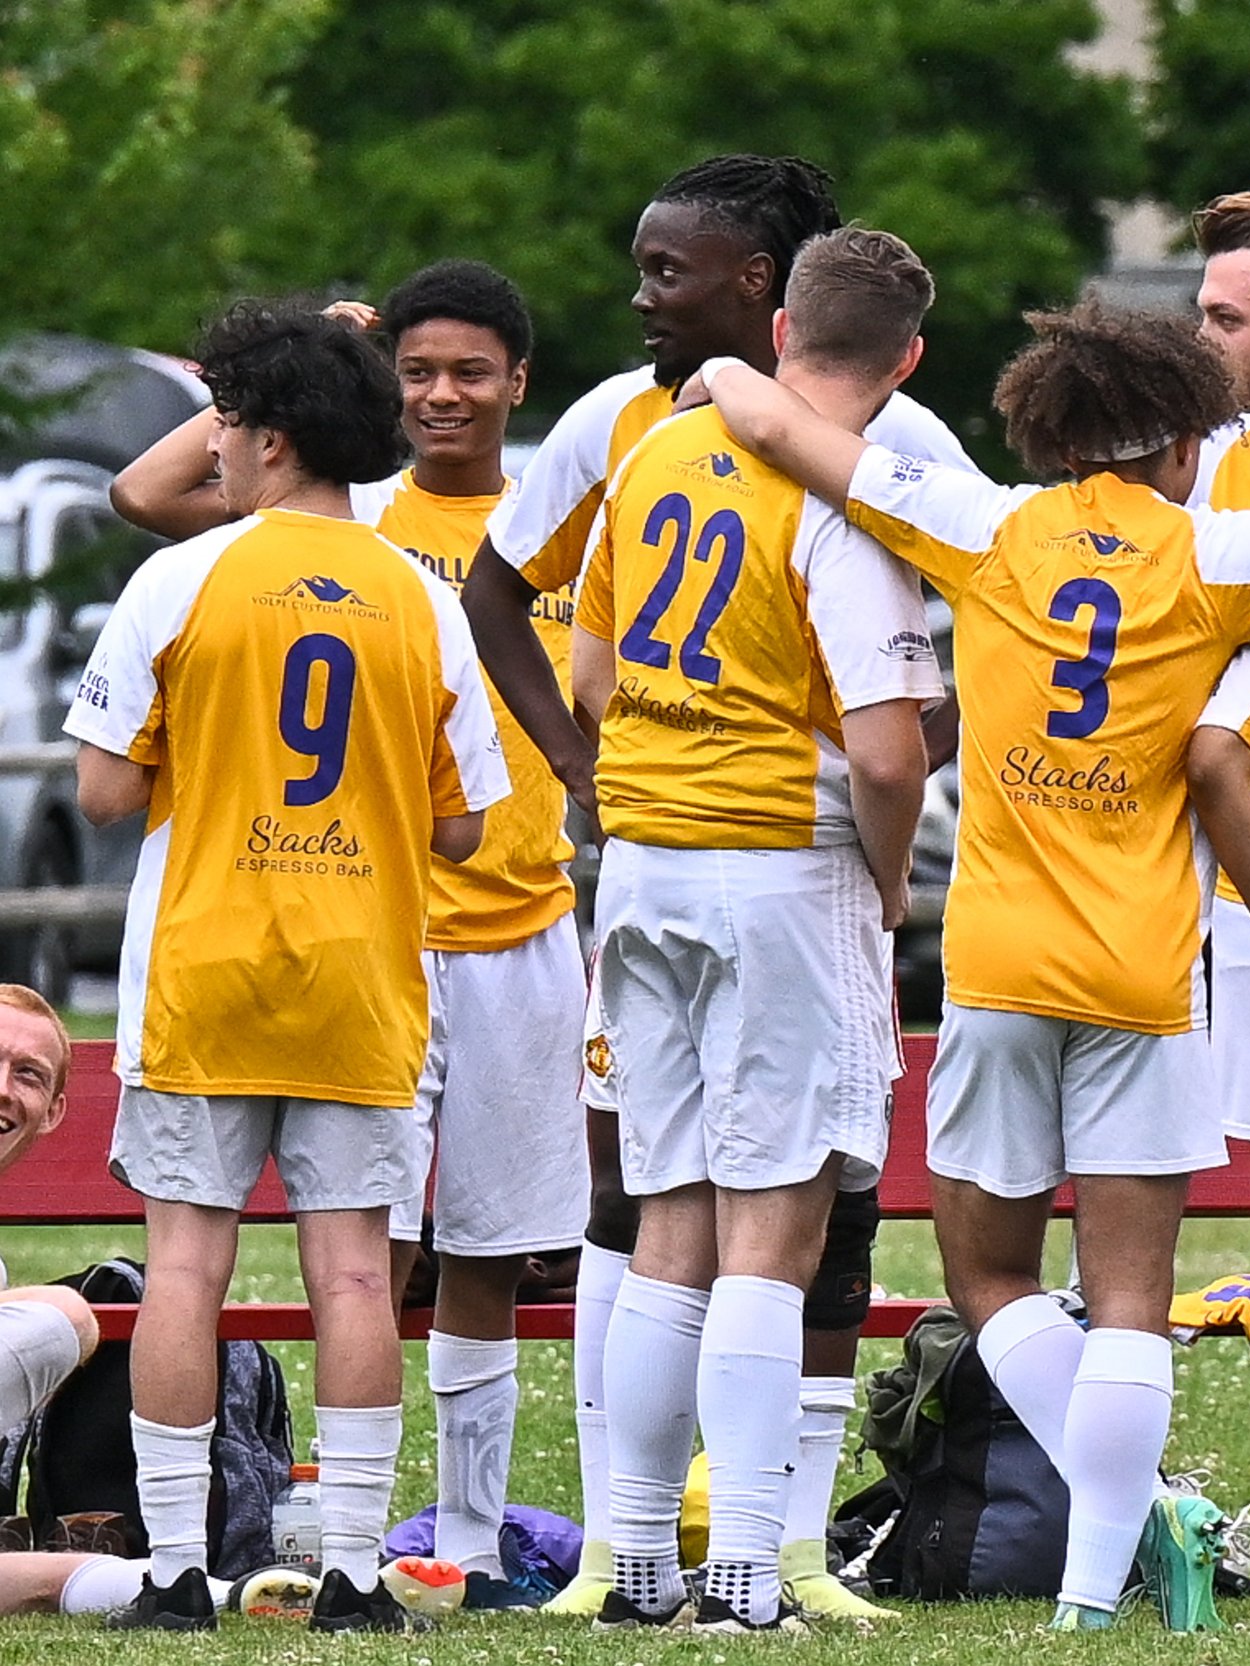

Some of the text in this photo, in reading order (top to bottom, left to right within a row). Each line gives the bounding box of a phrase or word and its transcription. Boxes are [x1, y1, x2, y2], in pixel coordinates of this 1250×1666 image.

[291, 601, 343, 615] CUSTOM
[347, 608, 390, 622] HOMES
[618, 492, 745, 686] 22
[1047, 578, 1122, 738] 3
[279, 633, 356, 806] 9
[1001, 746, 1133, 794] Stacks
[1102, 799, 1138, 814] BAR
[247, 815, 365, 857] Stacks
[235, 858, 373, 877] ESPRESSO BAR
